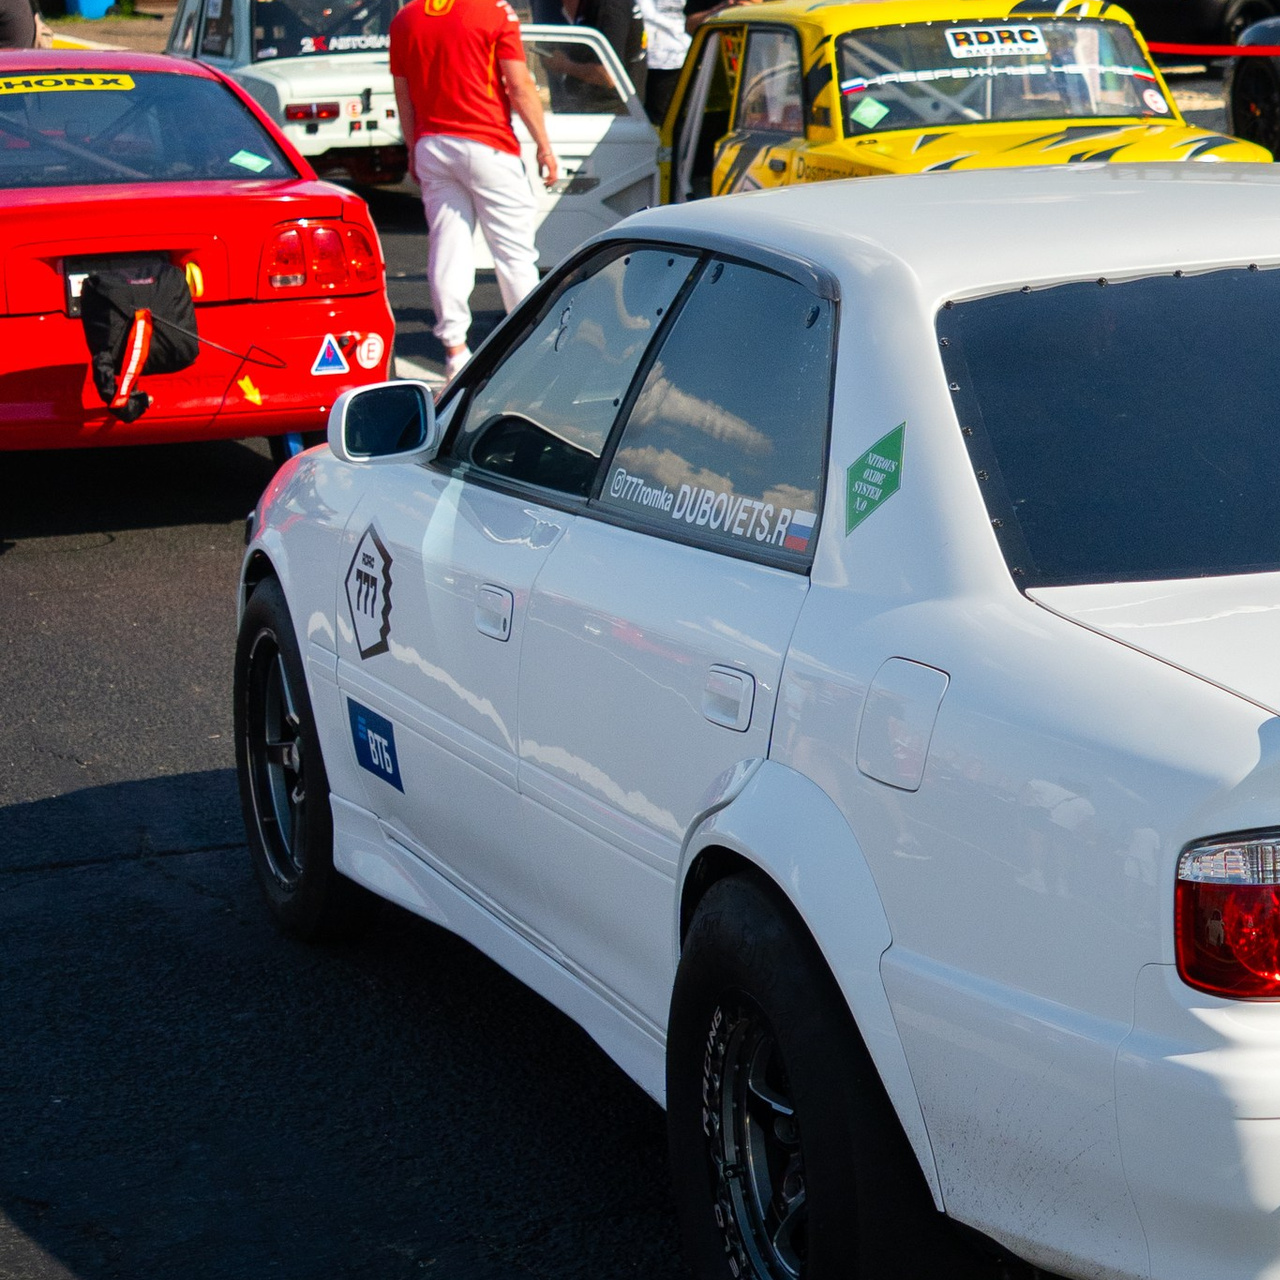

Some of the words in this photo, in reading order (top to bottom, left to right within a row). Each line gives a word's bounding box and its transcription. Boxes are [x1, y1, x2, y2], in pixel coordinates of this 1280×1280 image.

[949, 29, 1040, 47] RDRC
[366, 342, 376, 361] E
[865, 452, 898, 473] NITROUS
[863, 468, 886, 486] OXIDE
[852, 480, 882, 501] SYSTEM
[620, 474, 674, 512] 777romka
[672, 483, 793, 547] DUBOVETS.R
[361, 551, 375, 570] RDRC
[355, 567, 378, 619] 777
[367, 728, 394, 775] ВТБ
